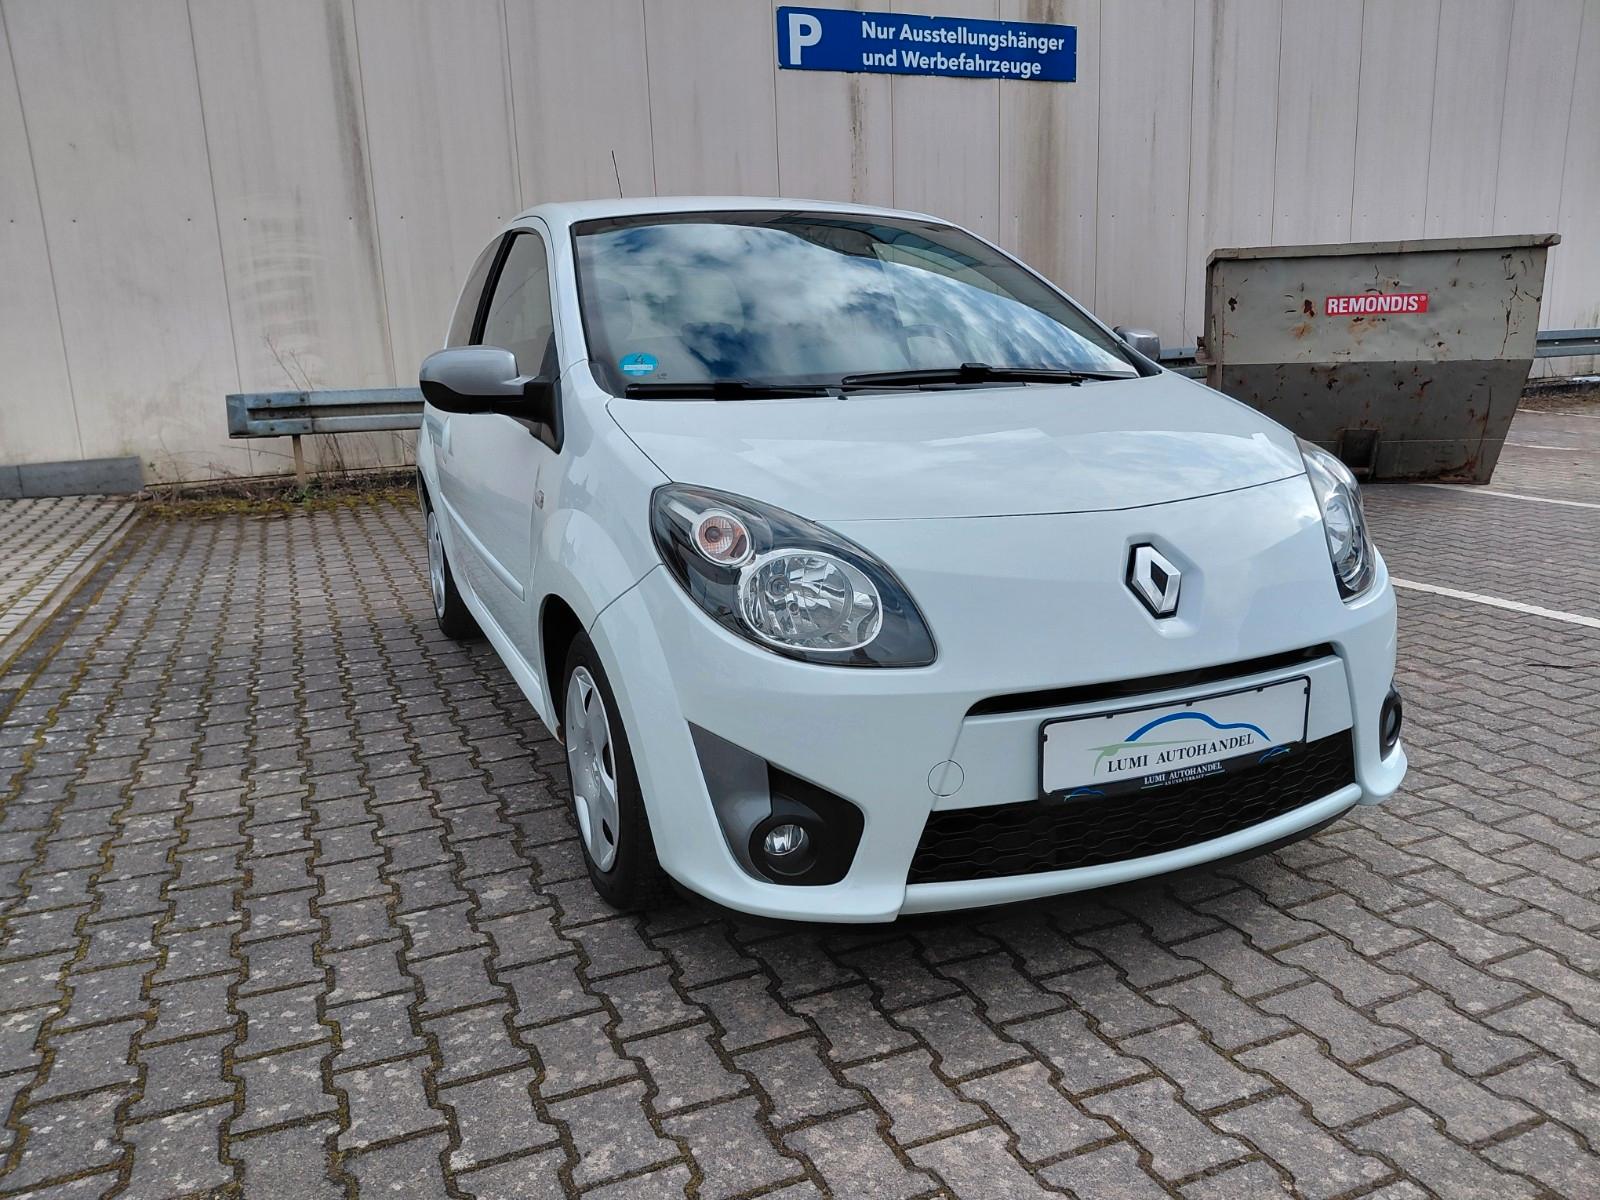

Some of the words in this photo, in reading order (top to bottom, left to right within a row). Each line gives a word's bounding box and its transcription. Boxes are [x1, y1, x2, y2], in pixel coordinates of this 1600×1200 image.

[788, 12, 823, 65] P
[862, 21, 896, 41] Nur
[899, 23, 1065, 54] Ausstellungshänger
[862, 50, 898, 67] und
[901, 50, 1042, 79] Werbefahrzeuge
[1107, 753, 1149, 773] LUMI
[1155, 733, 1255, 766] AUTOHANDEL
[1144, 774, 1166, 785] LUMI
[1168, 762, 1223, 780] AUTOHANDEL
